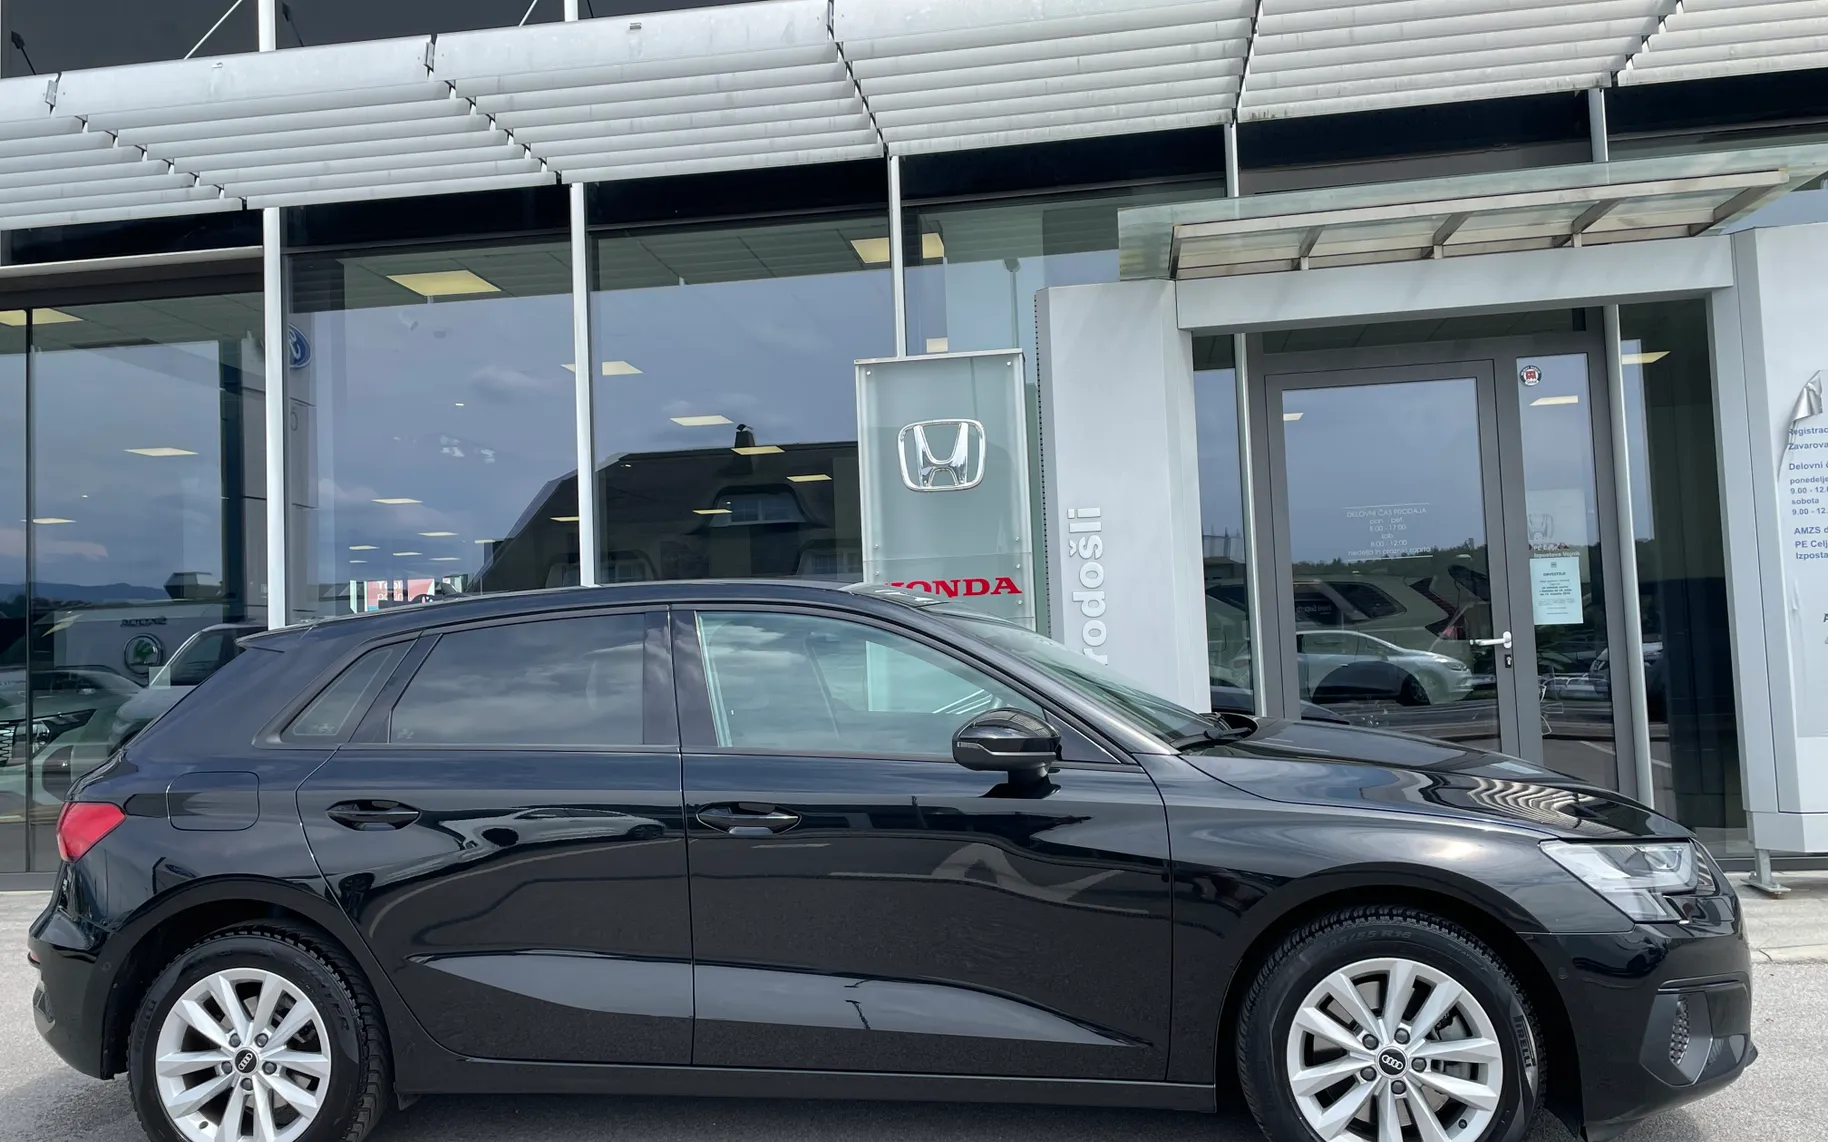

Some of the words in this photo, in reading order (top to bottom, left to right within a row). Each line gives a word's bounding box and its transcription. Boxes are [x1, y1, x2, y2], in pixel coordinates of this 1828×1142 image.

[1788, 442, 1828, 451] Zavarova
[1789, 461, 1823, 470] Delovni
[1790, 487, 1807, 495] 9.00
[1346, 509, 1376, 518] DELOVNI
[1377, 507, 1393, 516] ČAS
[1393, 507, 1427, 516] PRODAJA
[1792, 508, 1809, 516] 9.00
[1794, 526, 1821, 535] AMZS
[1795, 540, 1808, 548] PE
[884, 577, 1022, 598] ONDA
